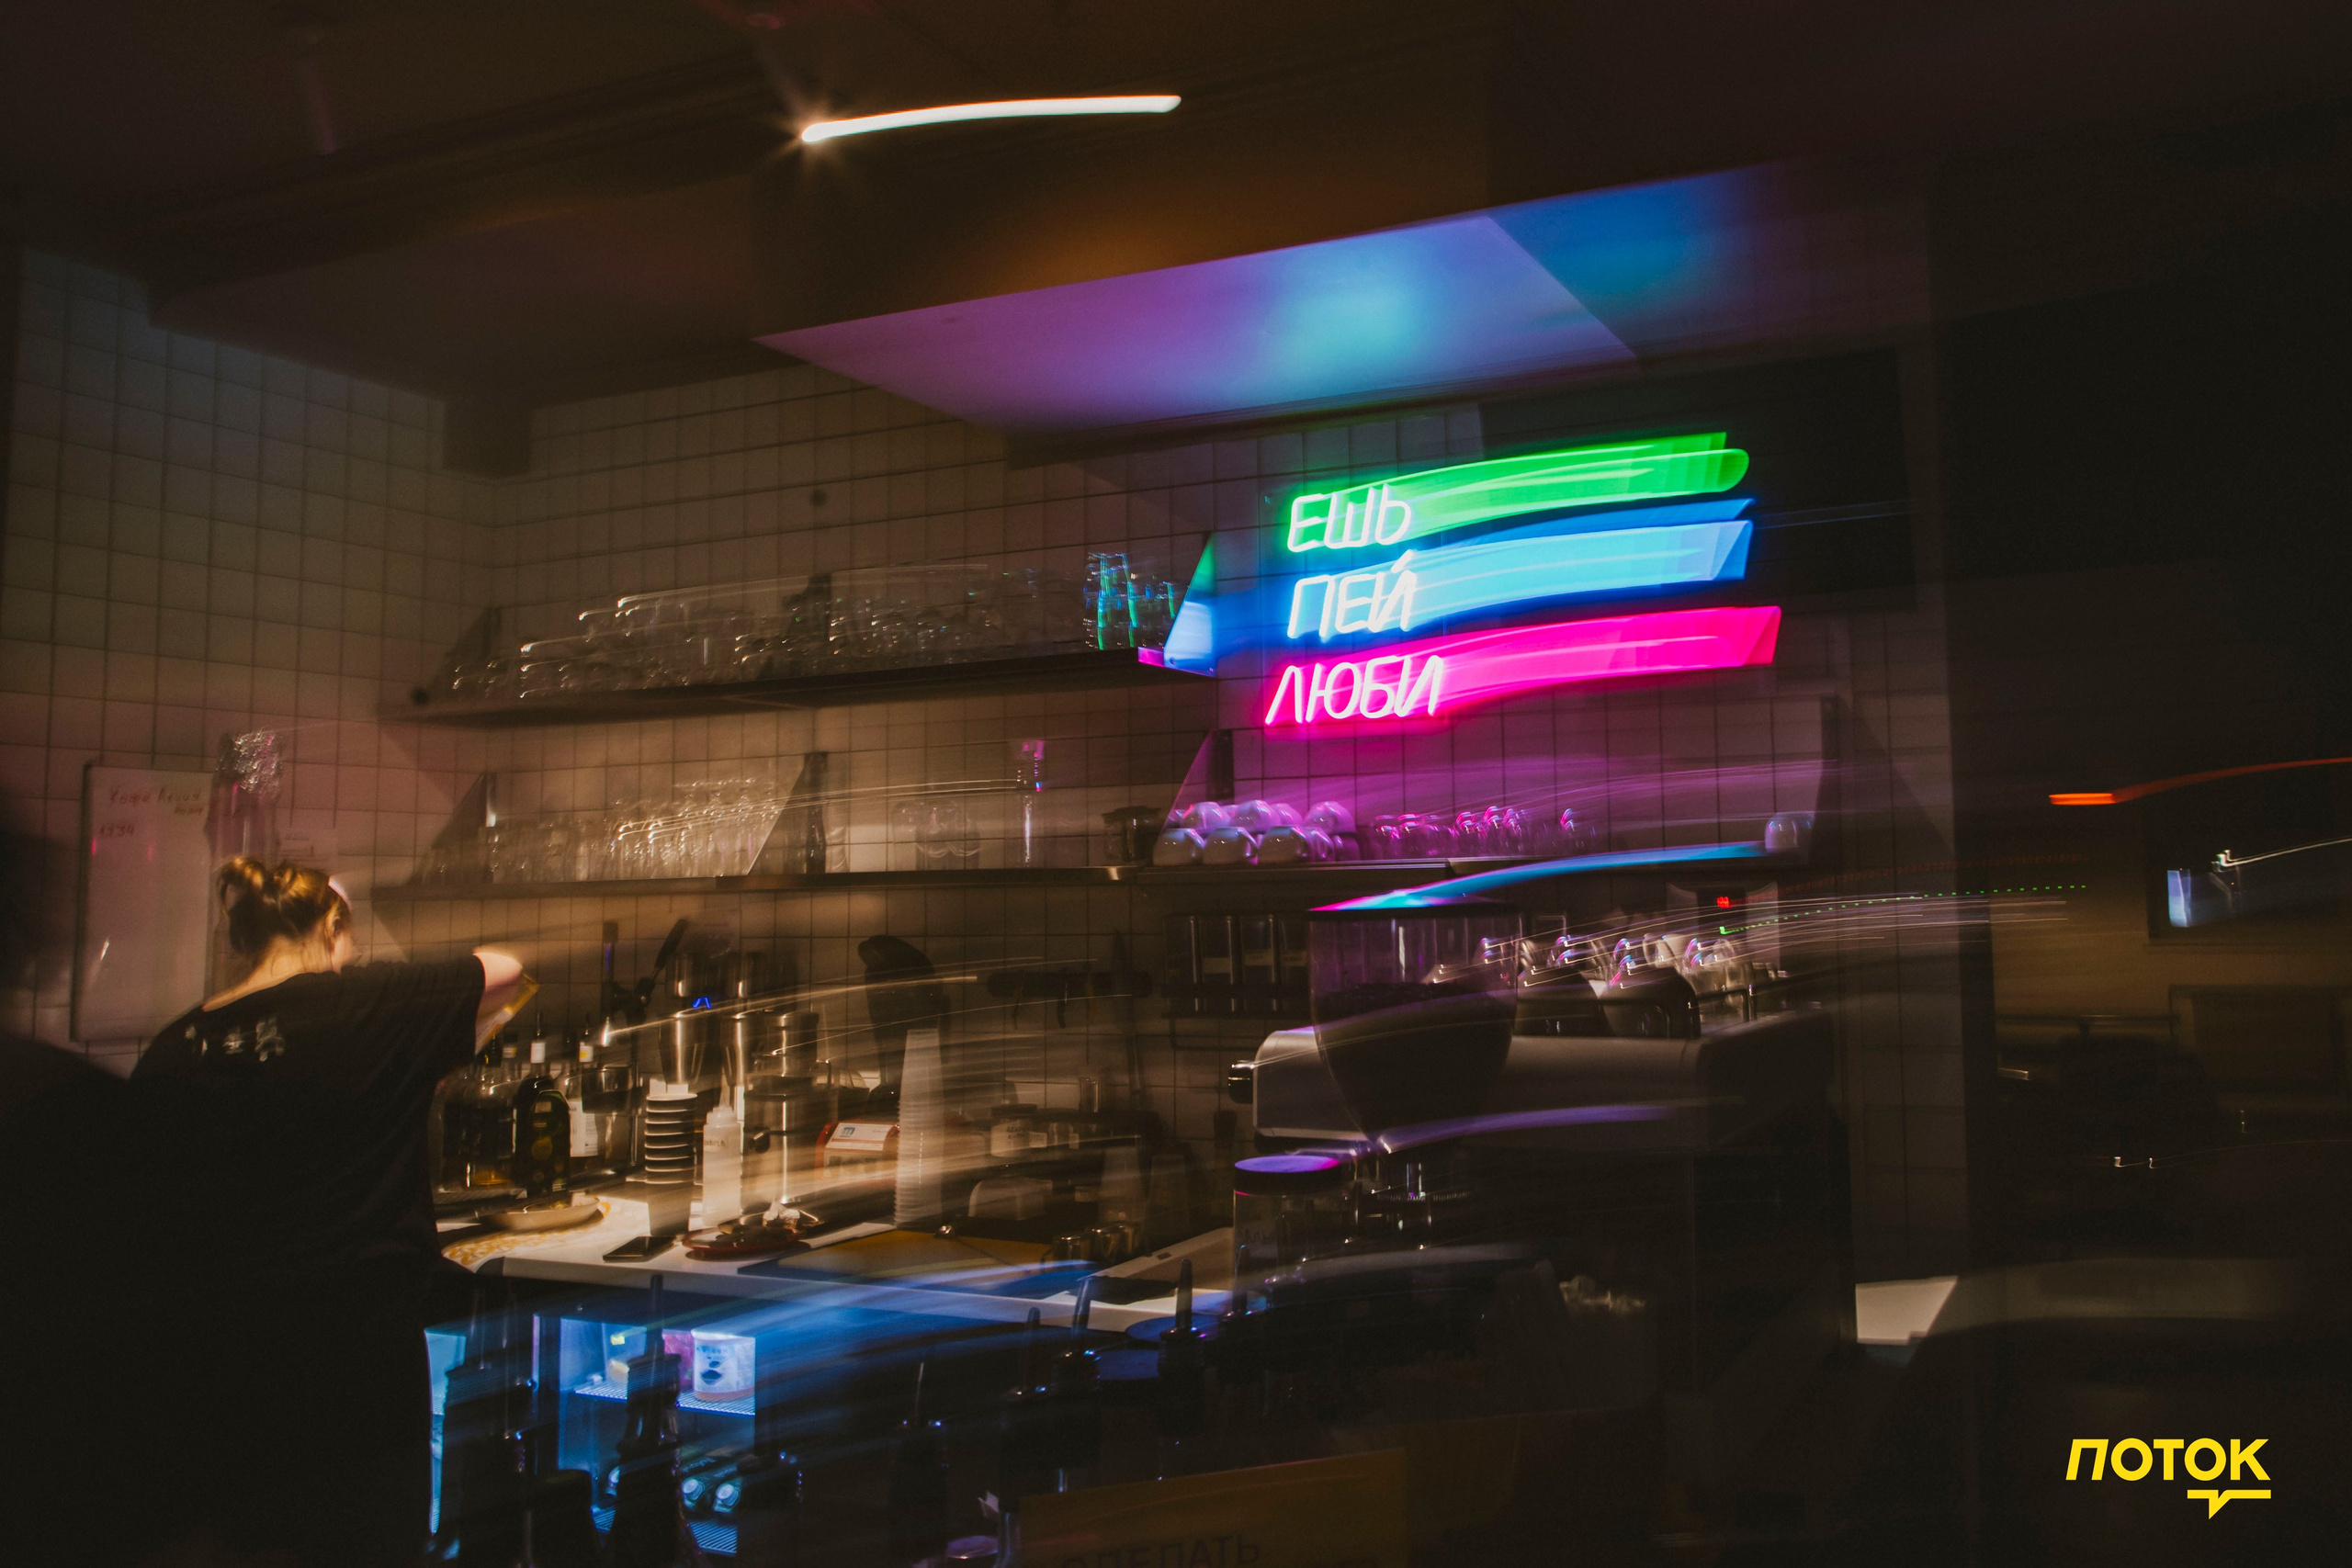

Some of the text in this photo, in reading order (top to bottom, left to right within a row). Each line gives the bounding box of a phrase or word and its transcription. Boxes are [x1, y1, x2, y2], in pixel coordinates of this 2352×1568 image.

[1286, 483, 1412, 552] ЕШЬ
[1286, 548, 1417, 642] ПЕЙ
[1264, 655, 1444, 726] ЛЮБИ
